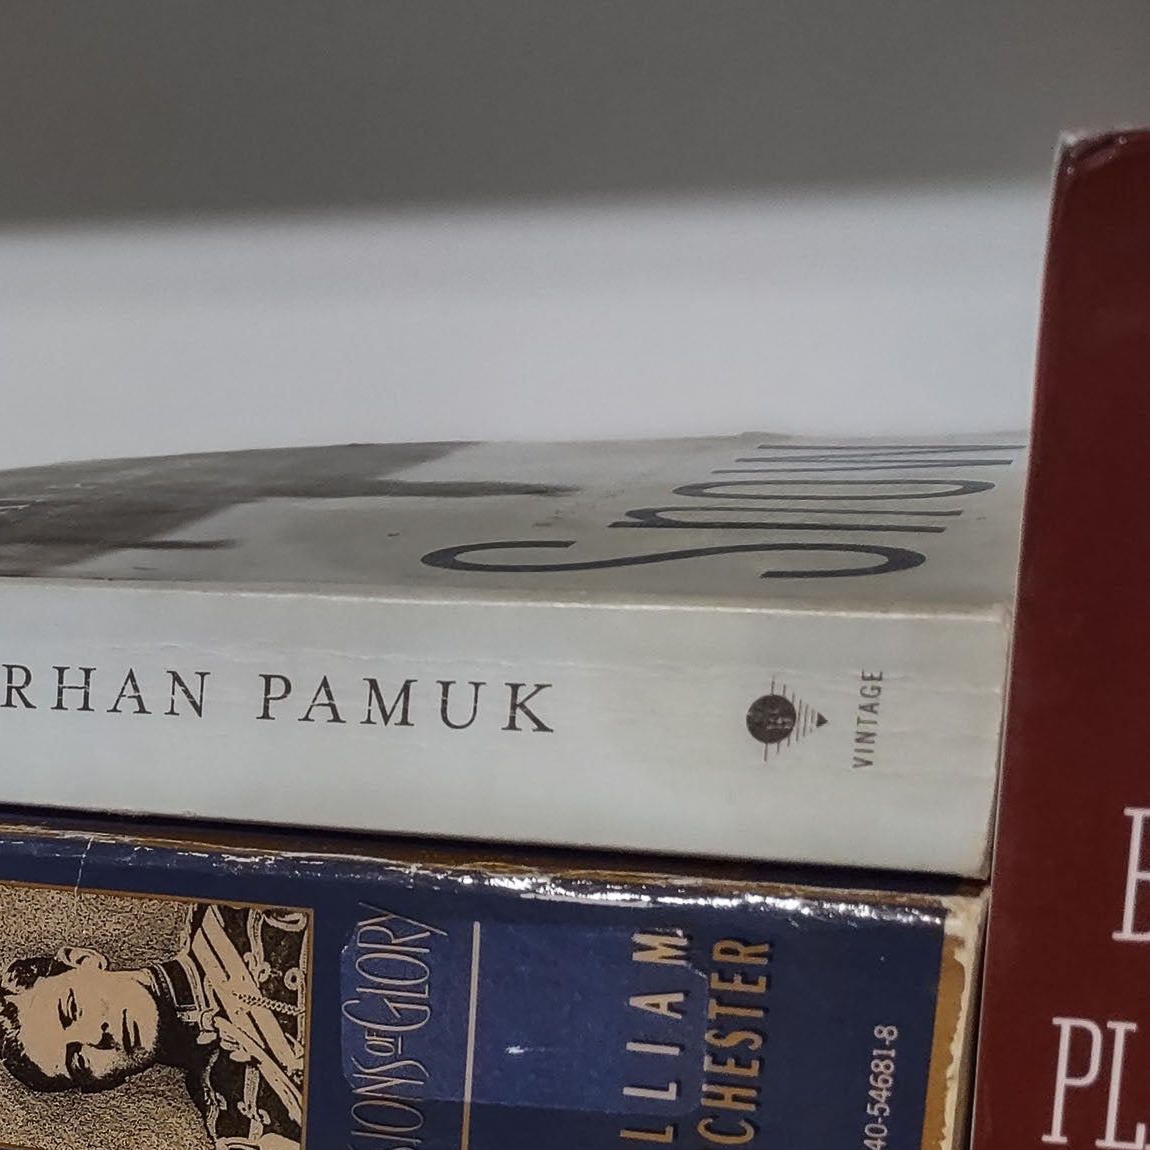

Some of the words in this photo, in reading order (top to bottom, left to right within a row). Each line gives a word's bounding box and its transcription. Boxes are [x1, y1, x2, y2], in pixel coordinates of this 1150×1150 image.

[255, 672, 554, 735] PAMUK
[851, 668, 884, 769] VINTAGE
[341, 901, 448, 1032] GLORY
